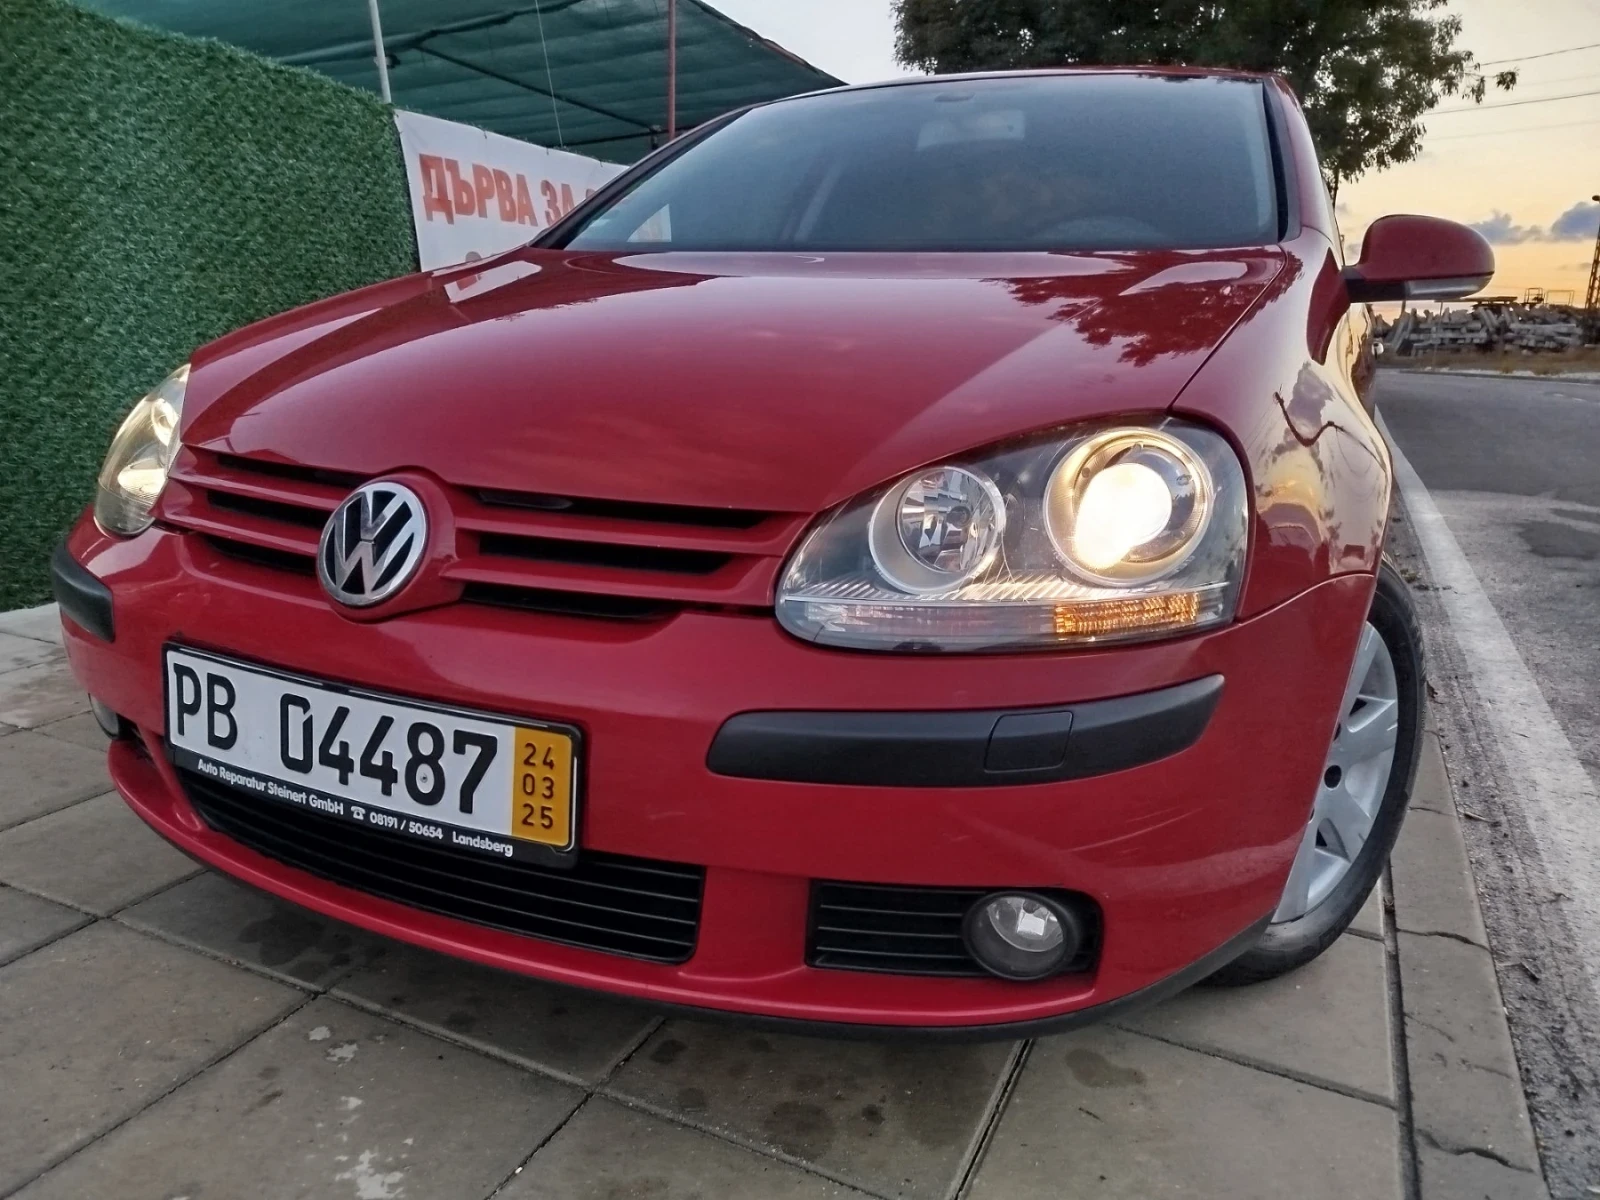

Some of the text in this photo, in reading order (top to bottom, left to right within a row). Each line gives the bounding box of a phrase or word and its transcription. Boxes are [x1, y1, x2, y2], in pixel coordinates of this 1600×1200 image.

[419, 153, 576, 227] ДЪРВА ЗА
[317, 482, 426, 606] VW
[173, 663, 498, 815] PB 04487
[523, 742, 554, 770] 24
[198, 759, 218, 776] Auto
[219, 766, 267, 792] Reparatur
[267, 781, 307, 805] Steinert
[309, 794, 344, 815] GmbH
[369, 811, 398, 829] 08191
[408, 821, 444, 840] 50654
[452, 831, 514, 857] Landsberg
[521, 803, 553, 830] 25
[522, 773, 554, 800] 03
